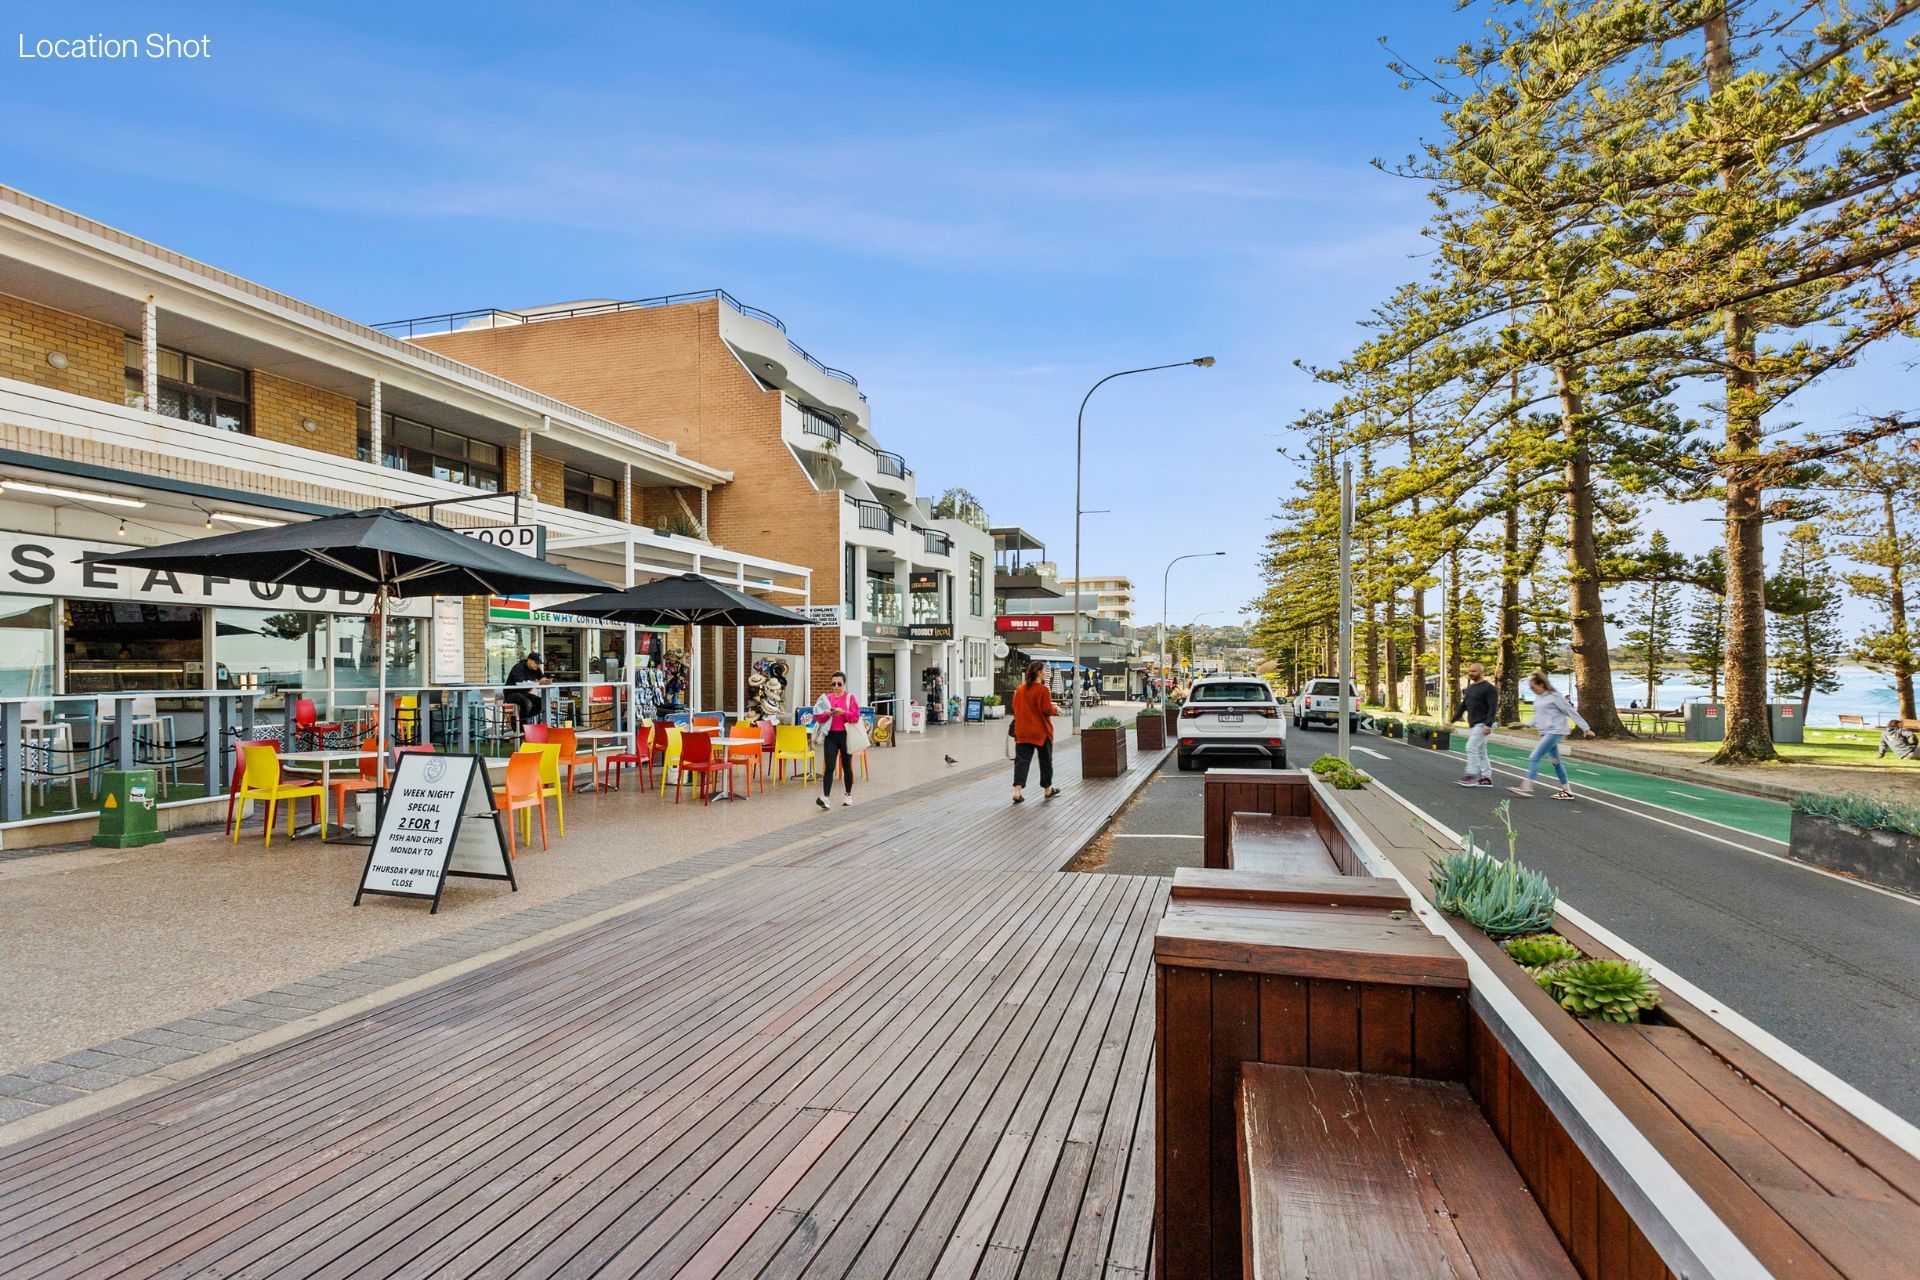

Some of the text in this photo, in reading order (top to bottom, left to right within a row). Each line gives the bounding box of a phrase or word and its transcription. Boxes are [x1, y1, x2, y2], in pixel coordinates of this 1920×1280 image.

[463, 529, 534, 546] OOD
[533, 612, 551, 620] DEE
[553, 613, 573, 623] WHY
[910, 627, 933, 636] PROUDLY
[403, 788, 455, 799] WEEK NIGHT
[408, 803, 440, 812] SPECIAL
[399, 817, 440, 830] 2 FOR 1
[423, 836, 443, 844] CHIPS
[390, 846, 422, 855] MONDAY
[372, 865, 439, 877] THURSDAY 4PM TILL
[391, 879, 413, 887] CLOSE
